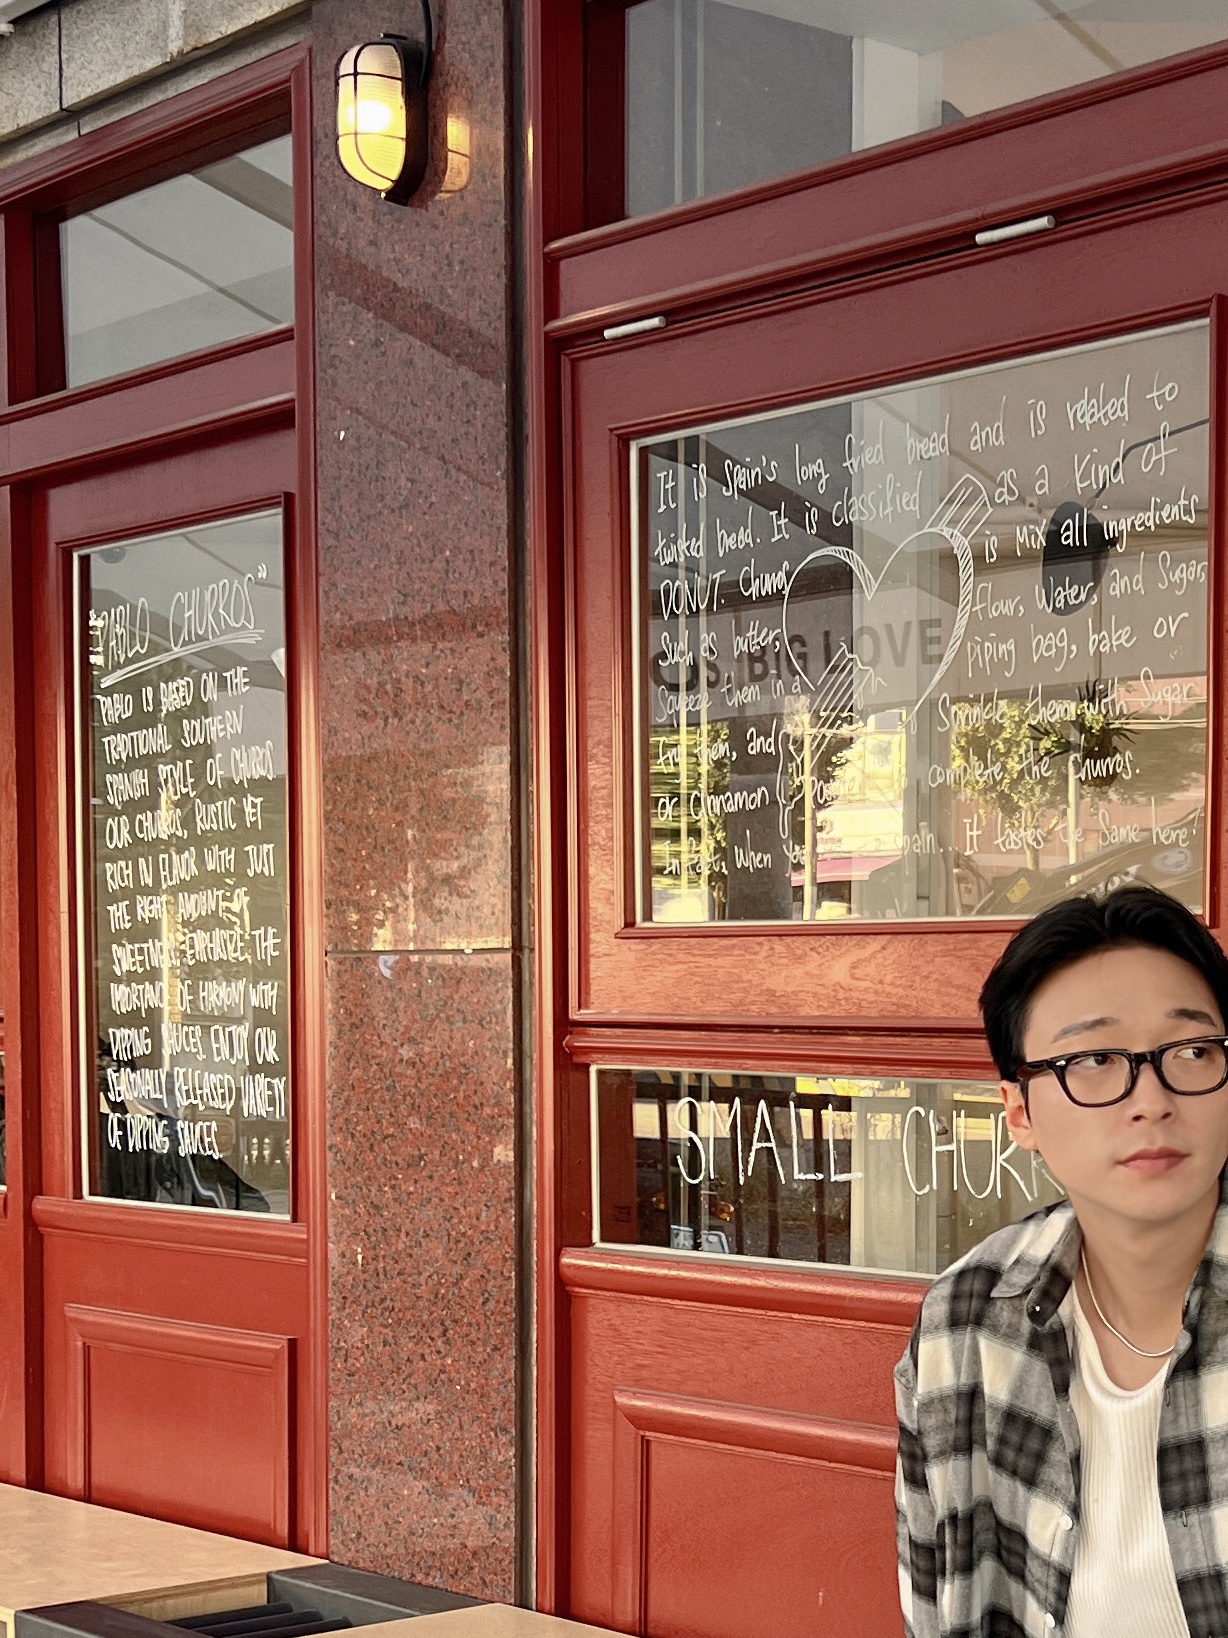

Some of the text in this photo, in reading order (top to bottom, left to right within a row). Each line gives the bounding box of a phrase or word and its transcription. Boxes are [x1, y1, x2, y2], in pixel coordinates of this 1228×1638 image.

[657, 469, 677, 513] It
[692, 463, 707, 501] is
[795, 443, 830, 494] long
[842, 420, 884, 475] fried
[906, 414, 950, 466] bread
[970, 395, 1007, 452] and
[1028, 398, 1047, 438] is
[1066, 374, 1131, 432] related
[1145, 369, 1179, 411] to
[654, 522, 704, 567] twisted
[716, 506, 761, 557] bread.
[768, 501, 790, 543] It
[804, 501, 819, 535] is
[994, 468, 1019, 505] as
[1035, 463, 1049, 497] a
[1140, 421, 1178, 476] of
[659, 568, 726, 622] DONUT.
[984, 530, 998, 563] is
[1060, 507, 1088, 547] all
[1102, 486, 1199, 553] ingredients
[700, 631, 718, 662] as
[732, 619, 782, 659] butter,
[971, 582, 1024, 621] flour,
[1109, 551, 1145, 599] and
[720, 671, 761, 707] them
[770, 669, 785, 699] in
[791, 675, 802, 695] a
[967, 633, 1015, 678] piping
[1030, 623, 1077, 672] bag,
[1088, 613, 1138, 655] bake
[1153, 612, 1189, 639] or
[823, 618, 943, 675] LOVE
[100, 666, 250, 726] PABLO IS BASED ON THE
[747, 719, 776, 756] and
[1025, 683, 1075, 725] them
[1083, 676, 1128, 716] with
[101, 705, 243, 765] TRADITIONAL SOUTHERN
[106, 769, 150, 808] SPANISH
[158, 760, 196, 800] STYLE
[206, 754, 224, 789] OF
[658, 796, 678, 821] or
[1019, 746, 1052, 780] the
[106, 815, 132, 849] OUR
[195, 797, 236, 835] RUSTIC
[242, 793, 263, 830] YET
[663, 841, 680, 875] In
[963, 814, 982, 856] It
[994, 811, 1044, 852] tastes
[1151, 796, 1201, 847] here!
[105, 858, 133, 893] RICH
[138, 856, 152, 887] IN
[204, 844, 235, 873] WITH
[244, 843, 275, 877] JUST
[107, 901, 132, 933] THE
[177, 887, 224, 923] AMOUNT
[233, 887, 249, 913] OF
[251, 926, 281, 966] THE
[109, 977, 279, 1017] IMPORTANC OF HARMONY WITH
[108, 1026, 151, 1061] DIPPING
[210, 1022, 249, 1066] ENJOY
[255, 1027, 279, 1065] OUR
[107, 1067, 286, 1119] SEASONALLY RELEASED VARIETY
[107, 1113, 223, 1160] OF DIPPING SAUCES.
[674, 1096, 863, 1186] SMALL
[902, 1105, 1065, 1202] CHURR
